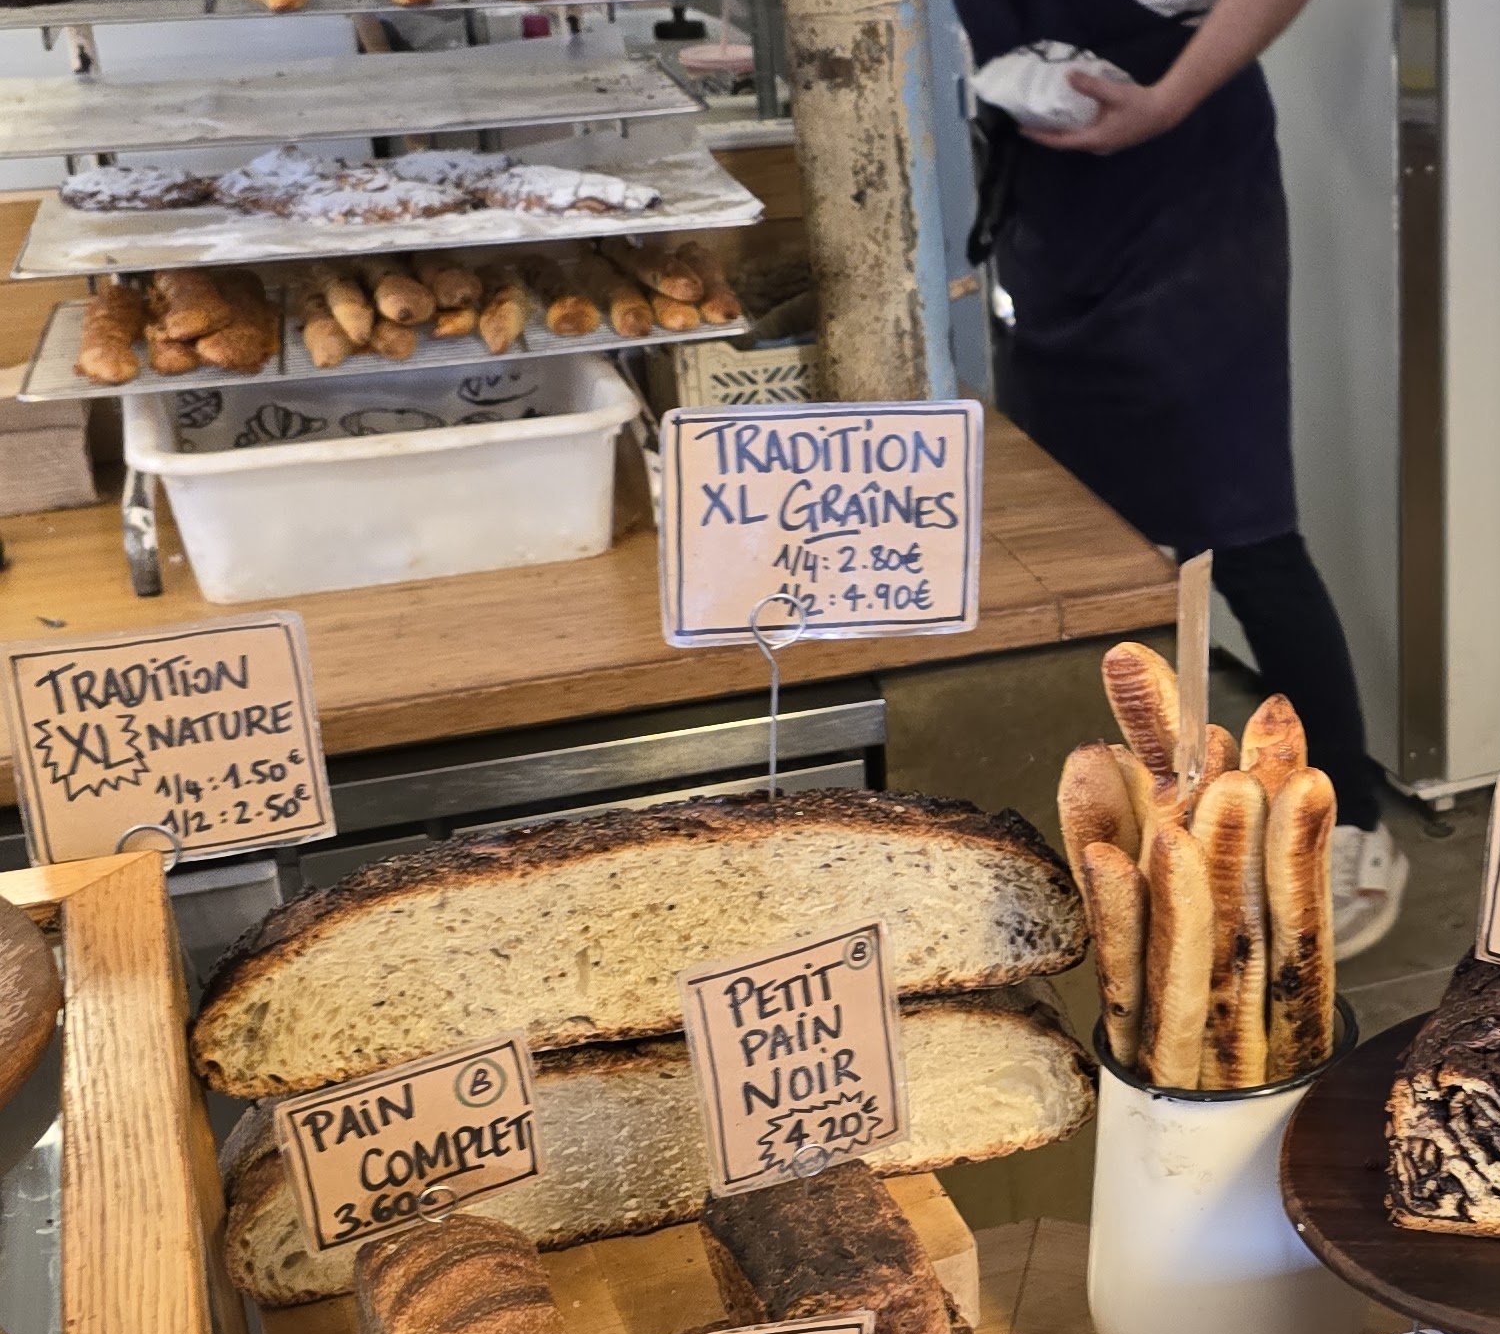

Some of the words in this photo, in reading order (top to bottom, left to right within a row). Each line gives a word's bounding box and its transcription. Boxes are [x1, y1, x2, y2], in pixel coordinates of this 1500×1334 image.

[701, 483, 769, 526] XL
[837, 543, 923, 573] 2.80€
[842, 580, 933, 611] 4.90€
[57, 722, 135, 776] XL
[146, 701, 293, 750] NATURE
[740, 1004, 842, 1067] PAiN
[302, 1083, 415, 1152] PAiN
[360, 1110, 534, 1192] COMPLET
